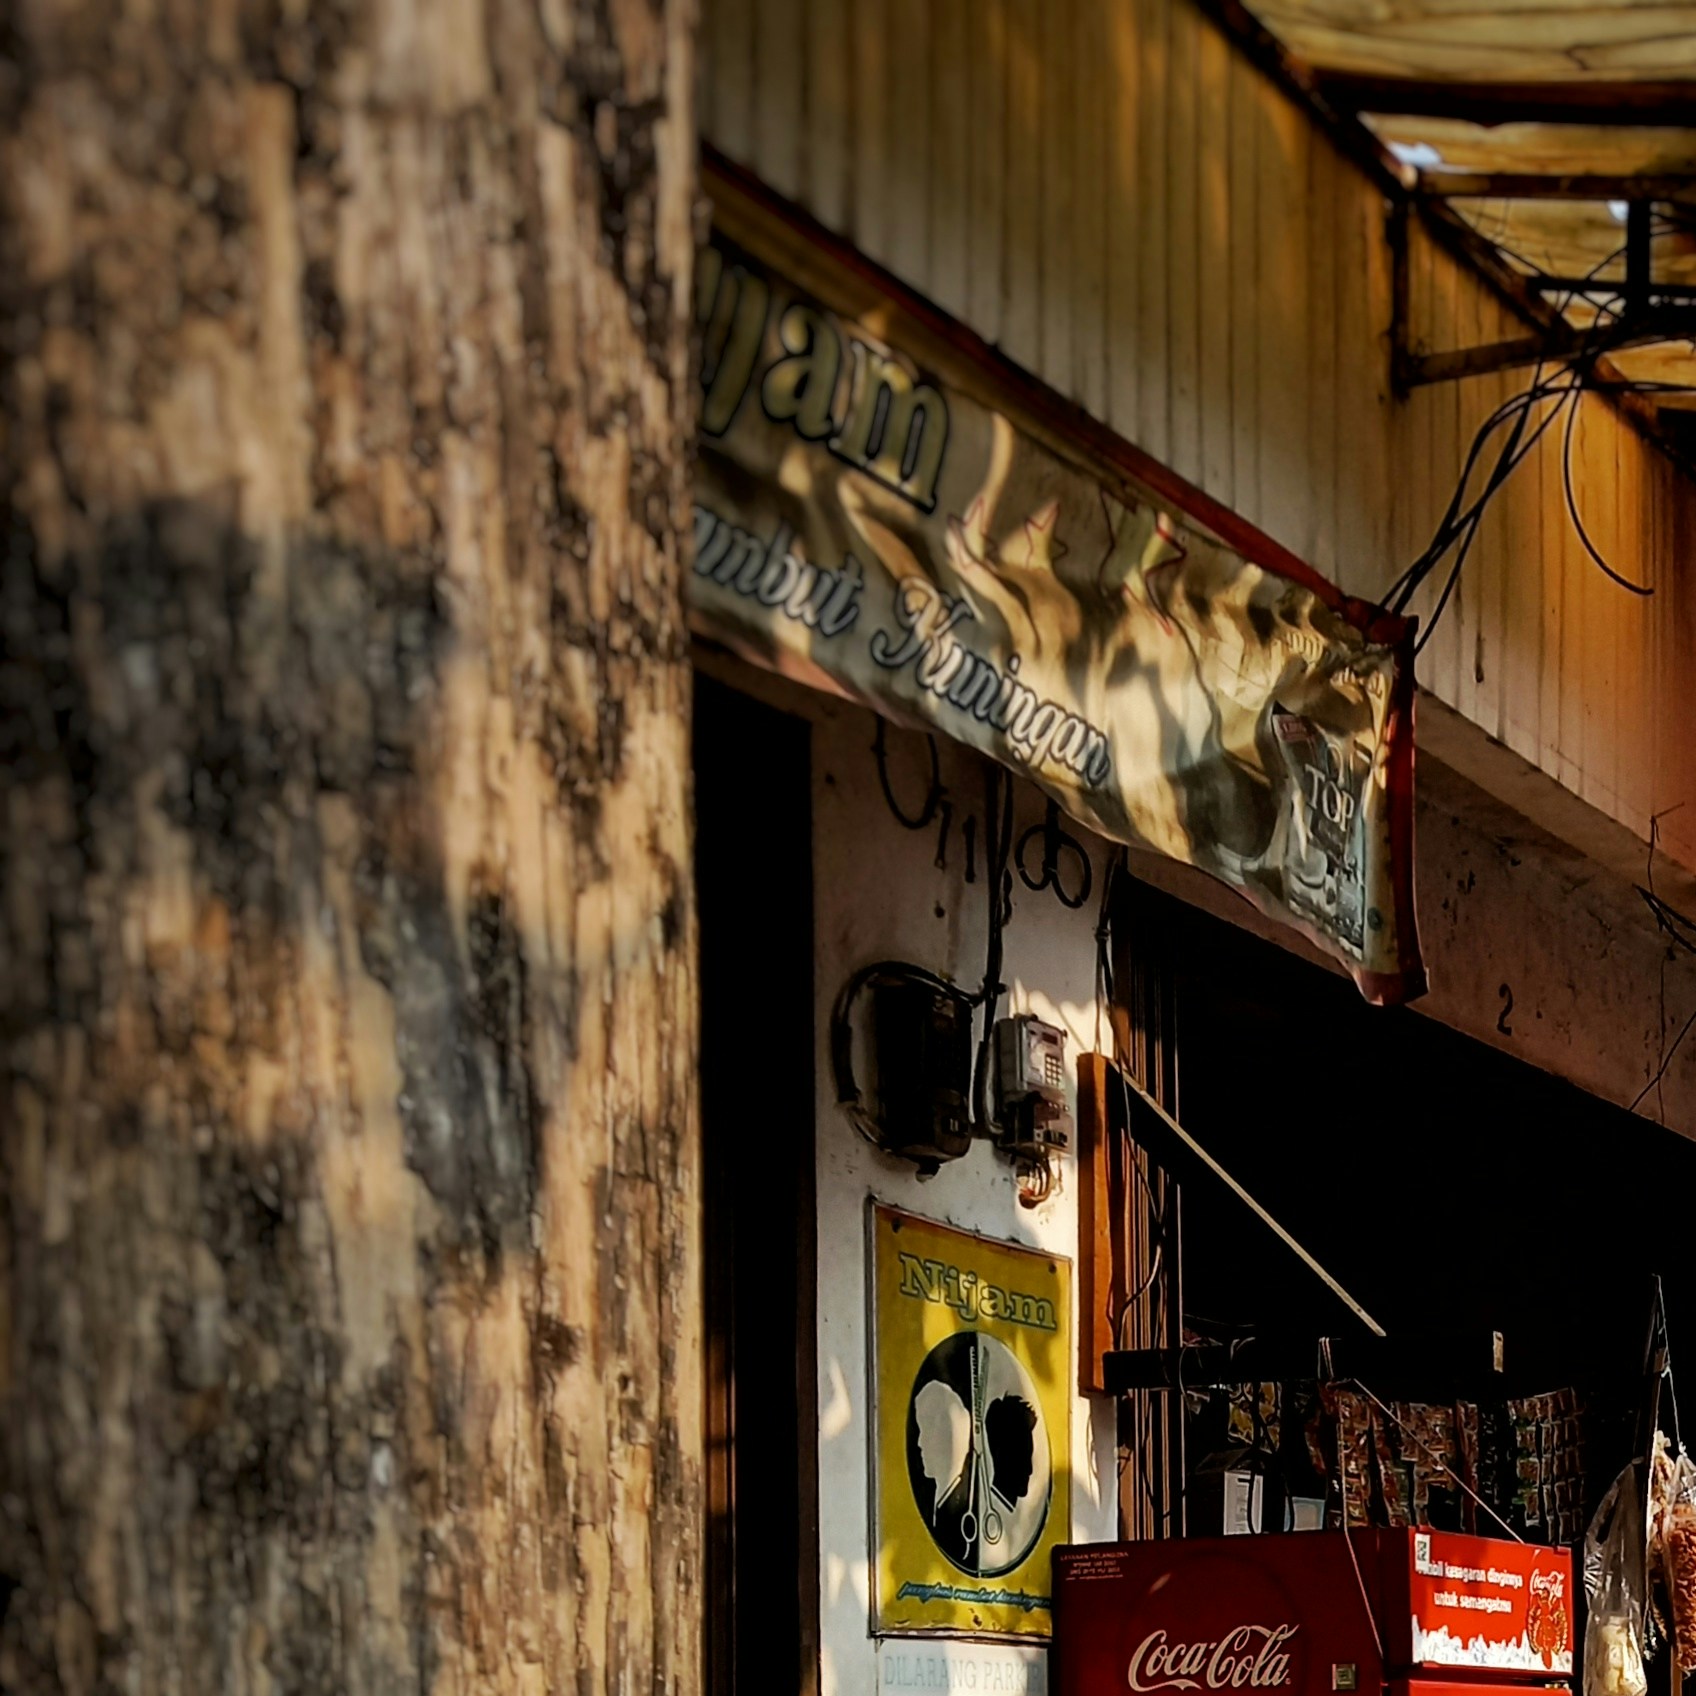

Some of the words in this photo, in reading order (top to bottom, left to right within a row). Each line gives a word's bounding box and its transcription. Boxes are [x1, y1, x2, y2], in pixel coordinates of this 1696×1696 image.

[870, 575, 1111, 788] Kuningan
[1303, 762, 1356, 833] TOP
[899, 1252, 1058, 1332] Nijam
[883, 1653, 978, 1691] DILARANG
[1127, 1622, 1300, 1693] Coca-Cola
